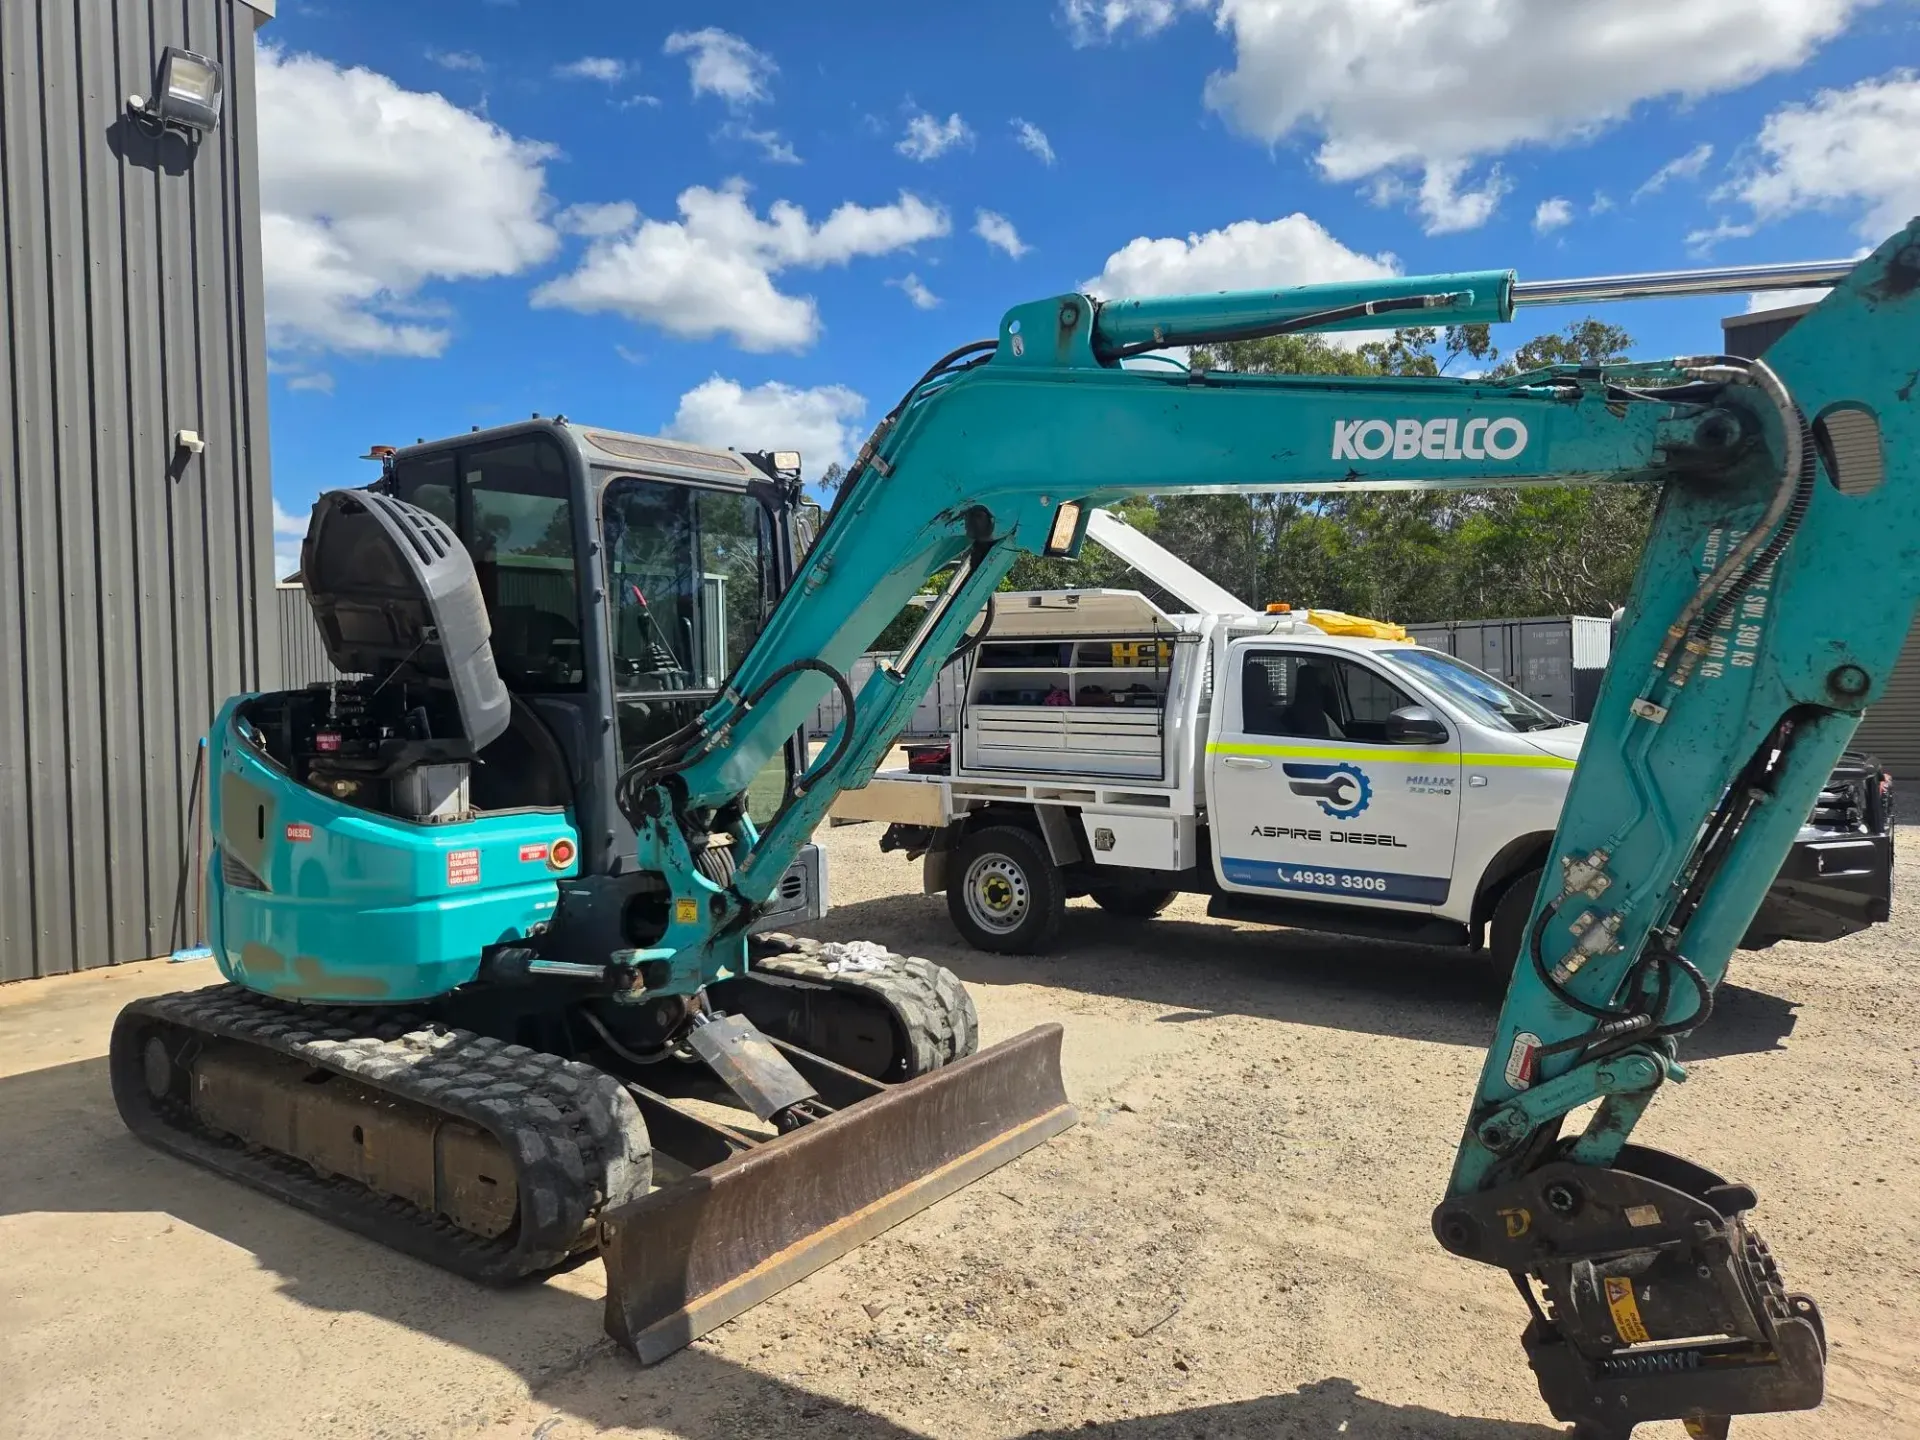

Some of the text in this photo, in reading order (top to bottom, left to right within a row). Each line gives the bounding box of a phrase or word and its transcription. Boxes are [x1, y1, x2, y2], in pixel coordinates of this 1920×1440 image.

[1331, 416, 1529, 460] KOBELCO
[1701, 528, 1723, 569] BUCKET
[1741, 595, 1768, 619] SWL
[1735, 623, 1762, 647] 390
[1709, 635, 1729, 658] 440
[1731, 650, 1756, 668] KG
[1700, 661, 1725, 678] KG
[1405, 776, 1456, 787] HILUX
[287, 827, 311, 838] DIESEL
[1251, 825, 1407, 848] ASPIRE DIESEL
[450, 851, 477, 860] STARTER
[450, 858, 478, 867] ISOLATOR
[450, 868, 477, 877] BATTERY
[450, 875, 478, 884] ISOLATOR
[1293, 870, 1386, 892] 4933 3306
